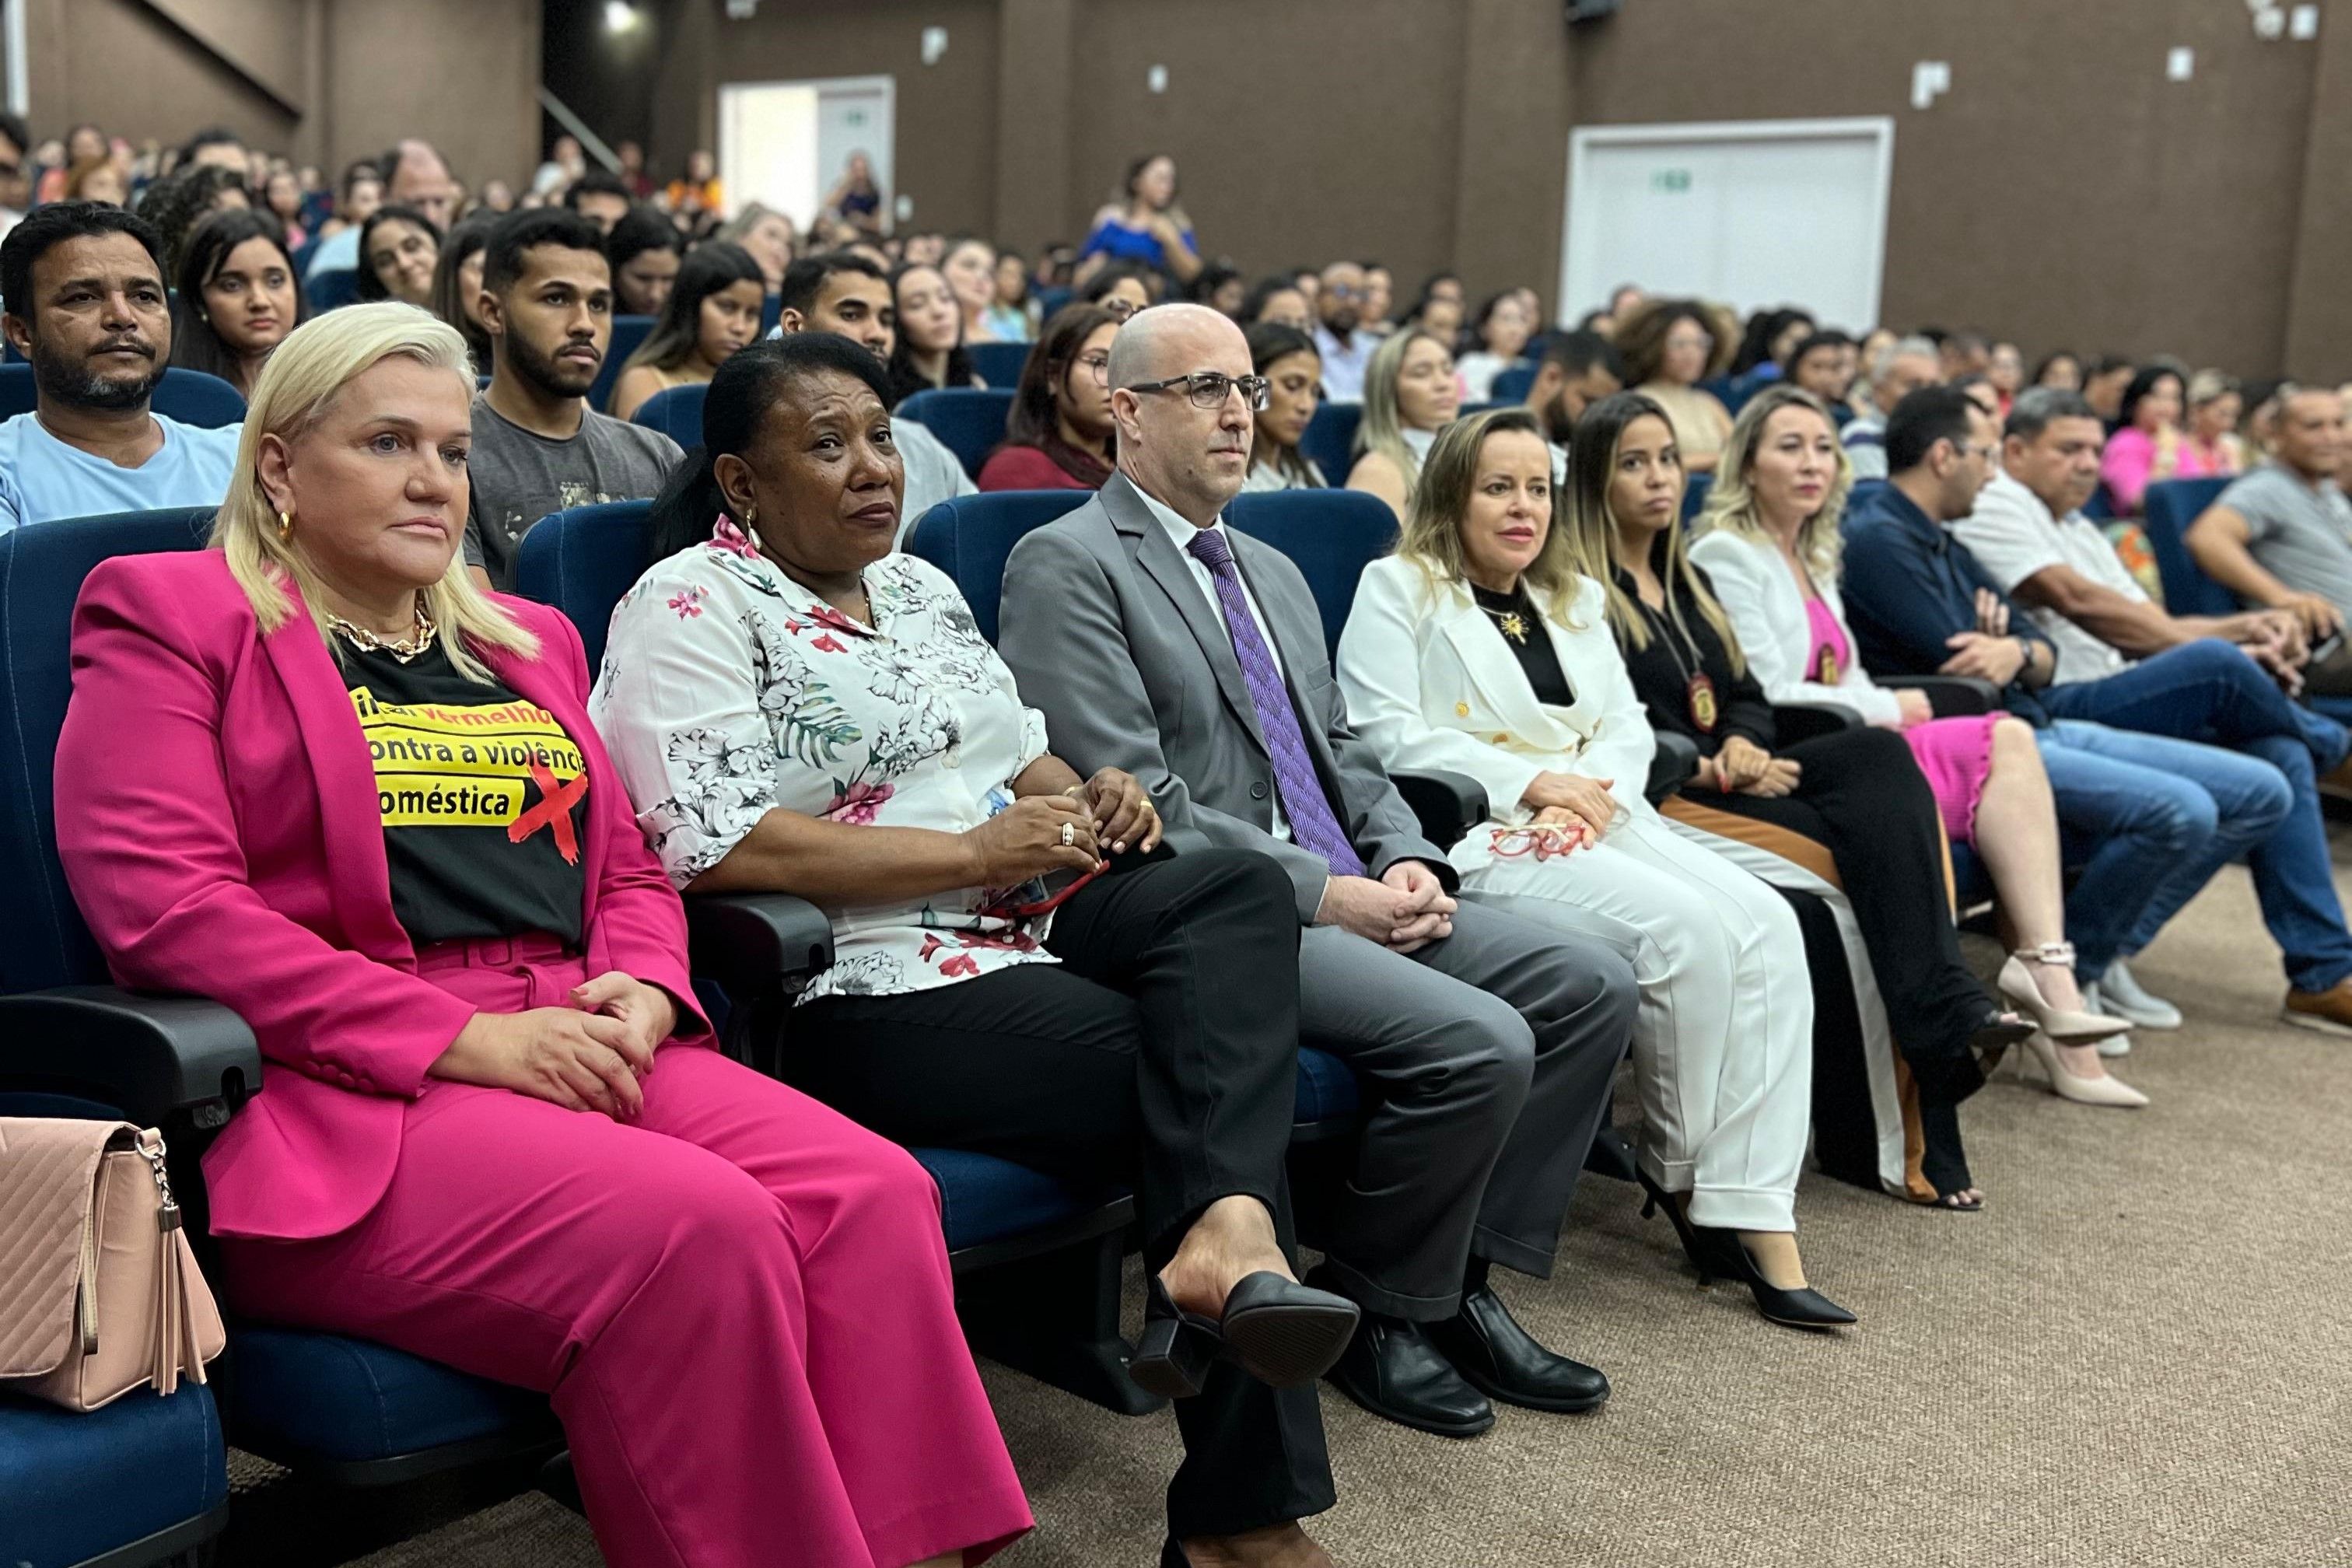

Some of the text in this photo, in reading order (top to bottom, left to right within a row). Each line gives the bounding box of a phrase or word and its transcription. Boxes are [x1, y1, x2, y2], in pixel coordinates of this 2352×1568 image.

[367, 737, 453, 762] ontra
[460, 744, 478, 764] a
[379, 782, 510, 816] oméstica
